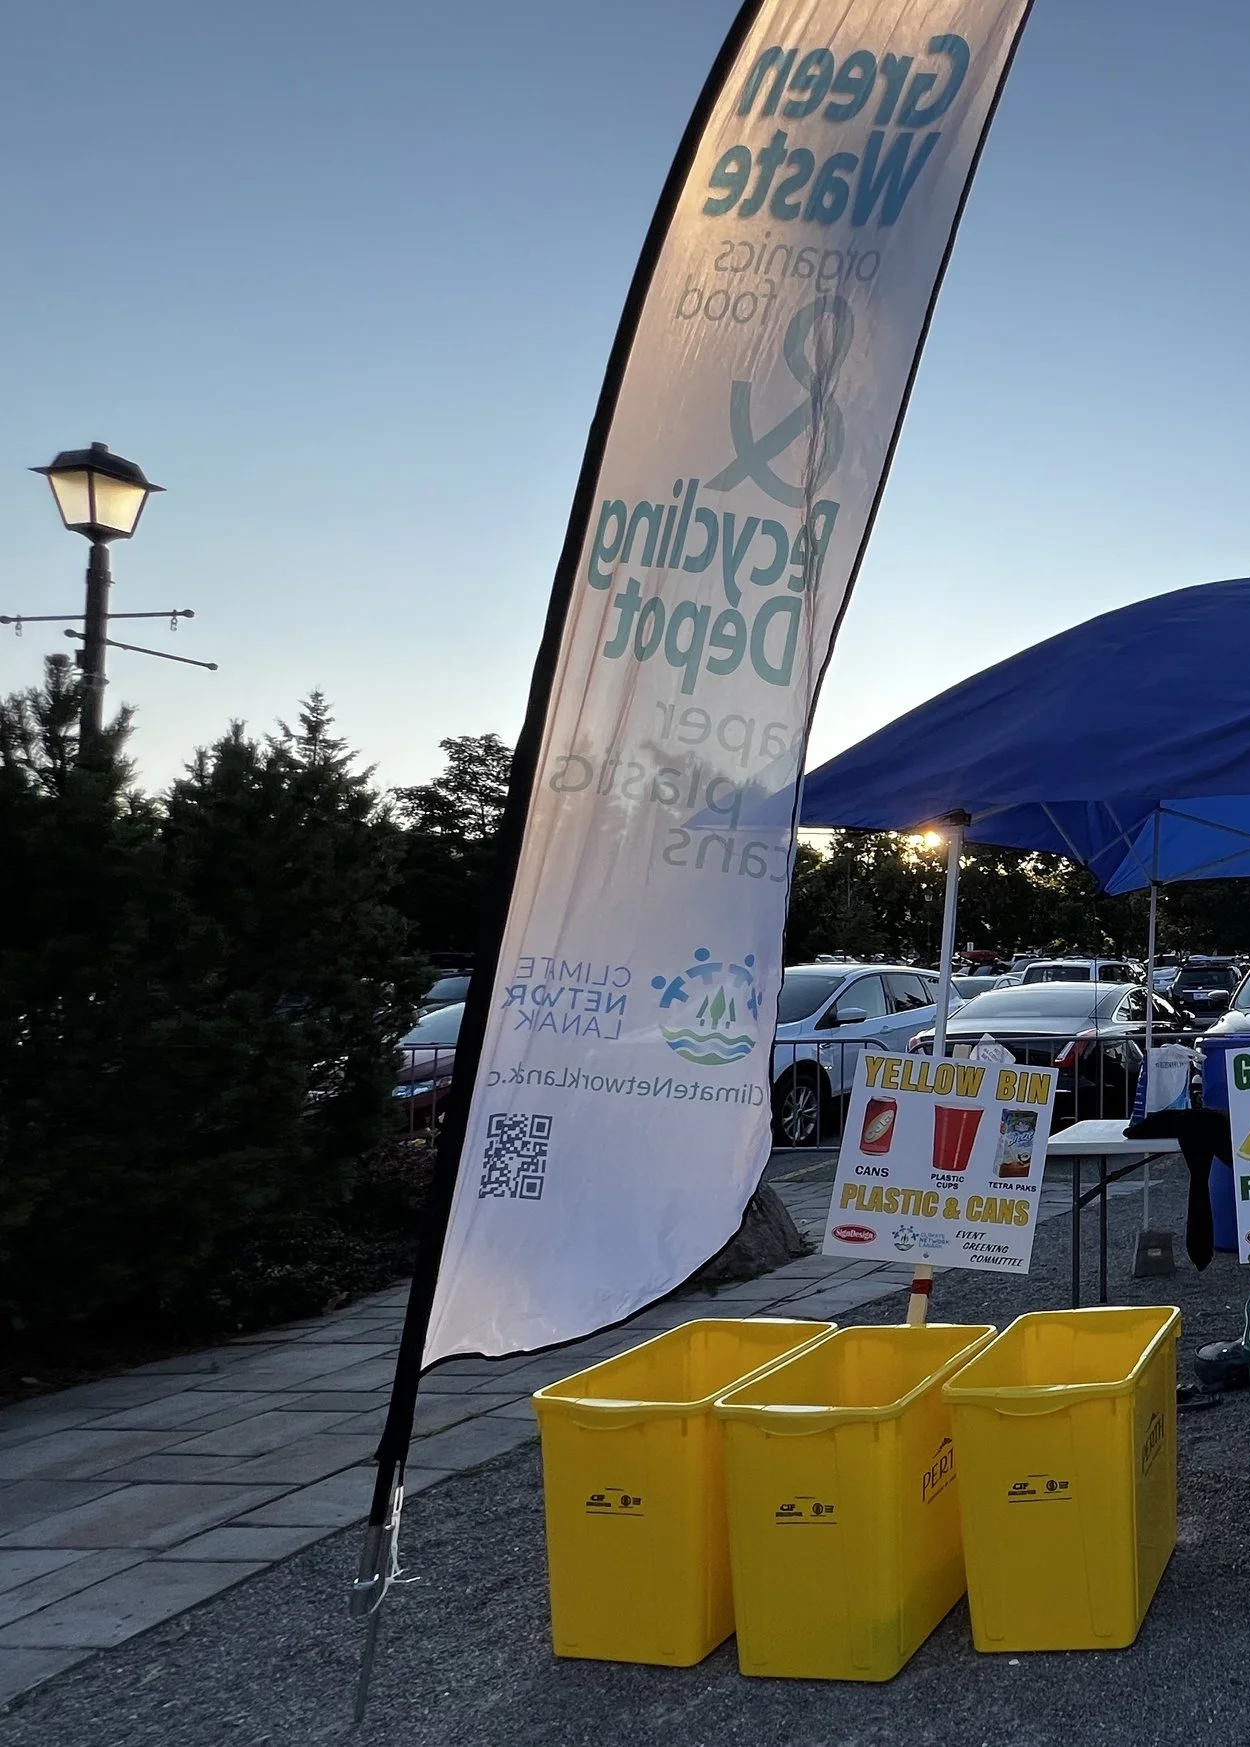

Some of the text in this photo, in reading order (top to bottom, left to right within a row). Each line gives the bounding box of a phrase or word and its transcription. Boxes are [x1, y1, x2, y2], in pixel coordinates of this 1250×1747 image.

[865, 1055, 1051, 1105] YELLOW BIN
[855, 1165, 889, 1178] CANS
[930, 1173, 965, 1183] PLASTIC
[936, 1182, 959, 1190] CUPS
[988, 1181, 1037, 1192] TETRA PAKS
[839, 1182, 1031, 1227] PLASTIC & CANS
[956, 1230, 986, 1240] EVENT
[962, 1241, 1009, 1254] GREENING
[969, 1254, 1024, 1267] COMMITTEE
[922, 1448, 954, 1502] PERT
